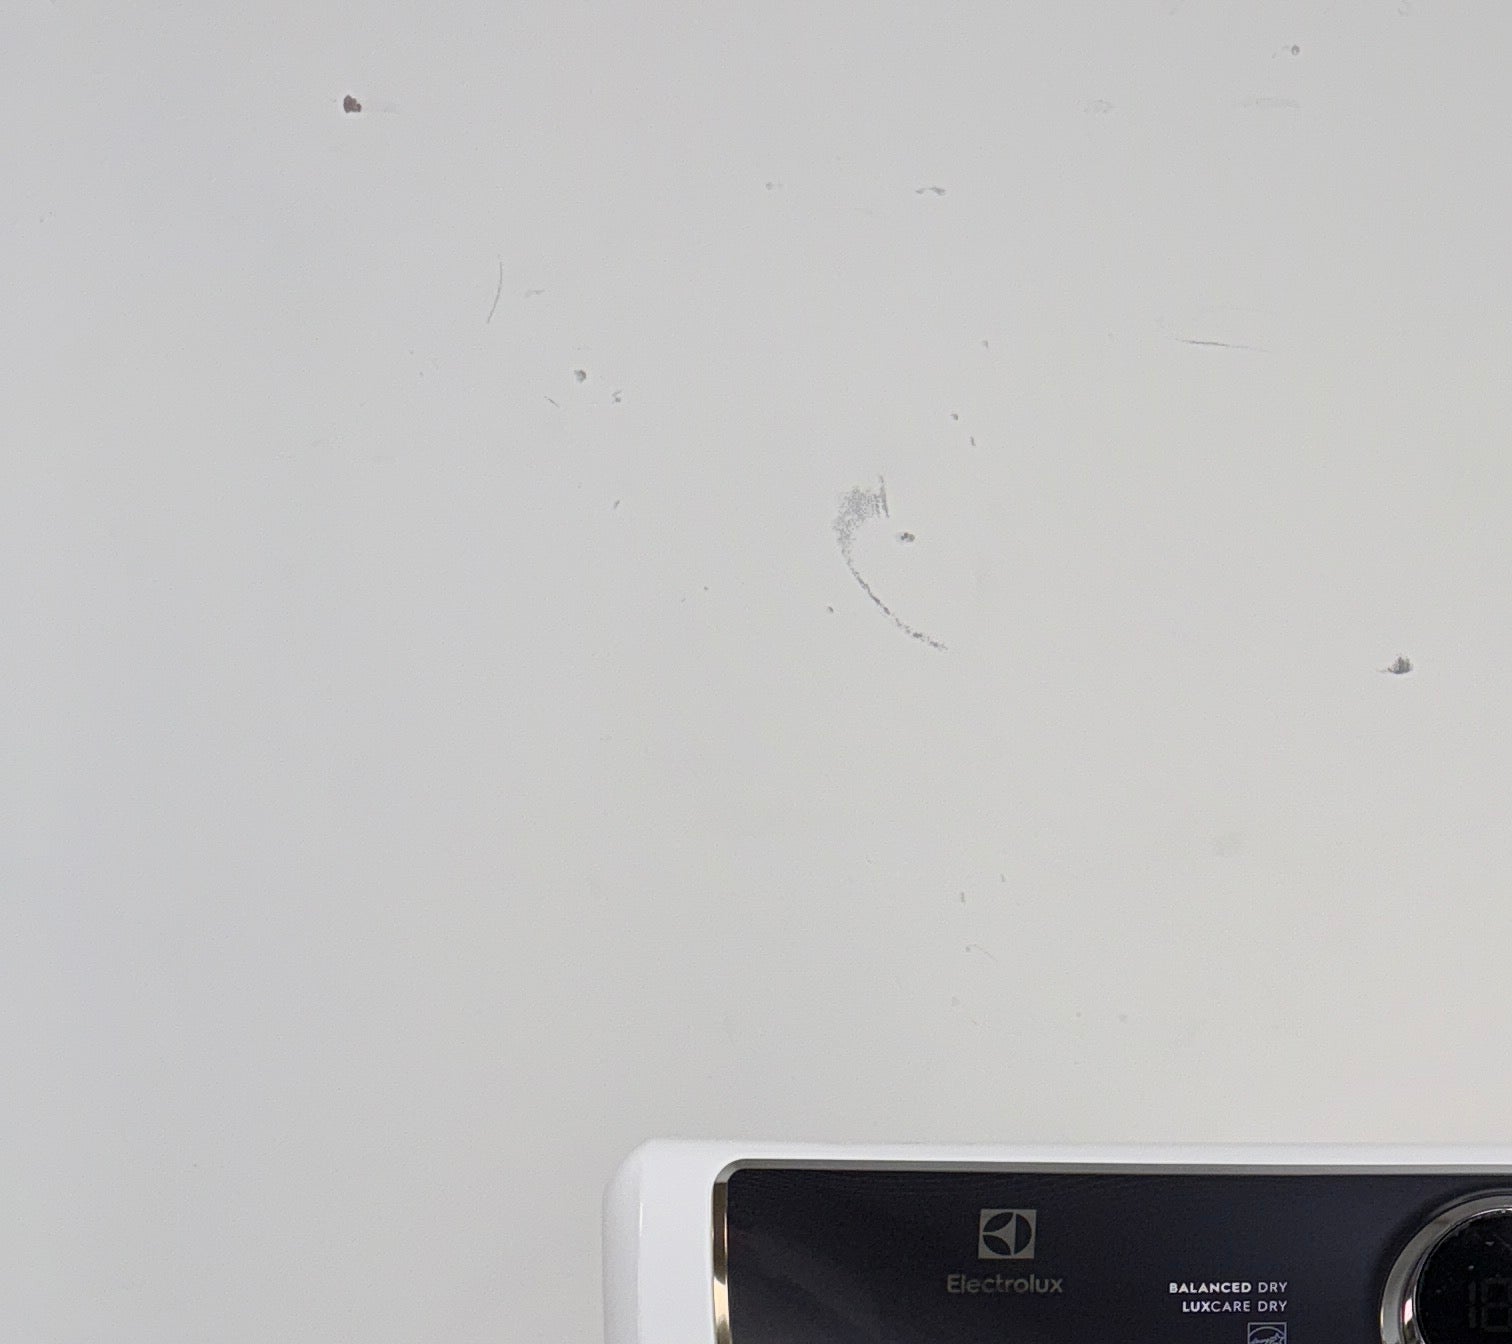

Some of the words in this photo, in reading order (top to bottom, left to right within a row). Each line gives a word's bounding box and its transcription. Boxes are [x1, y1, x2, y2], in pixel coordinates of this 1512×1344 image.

[946, 1273, 1064, 1295] Electrolux
[1168, 1281, 1252, 1295] BALANCED
[1257, 1281, 1289, 1294] DRY
[1181, 1300, 1252, 1314] LUXCARE
[1257, 1300, 1289, 1313] DRY
